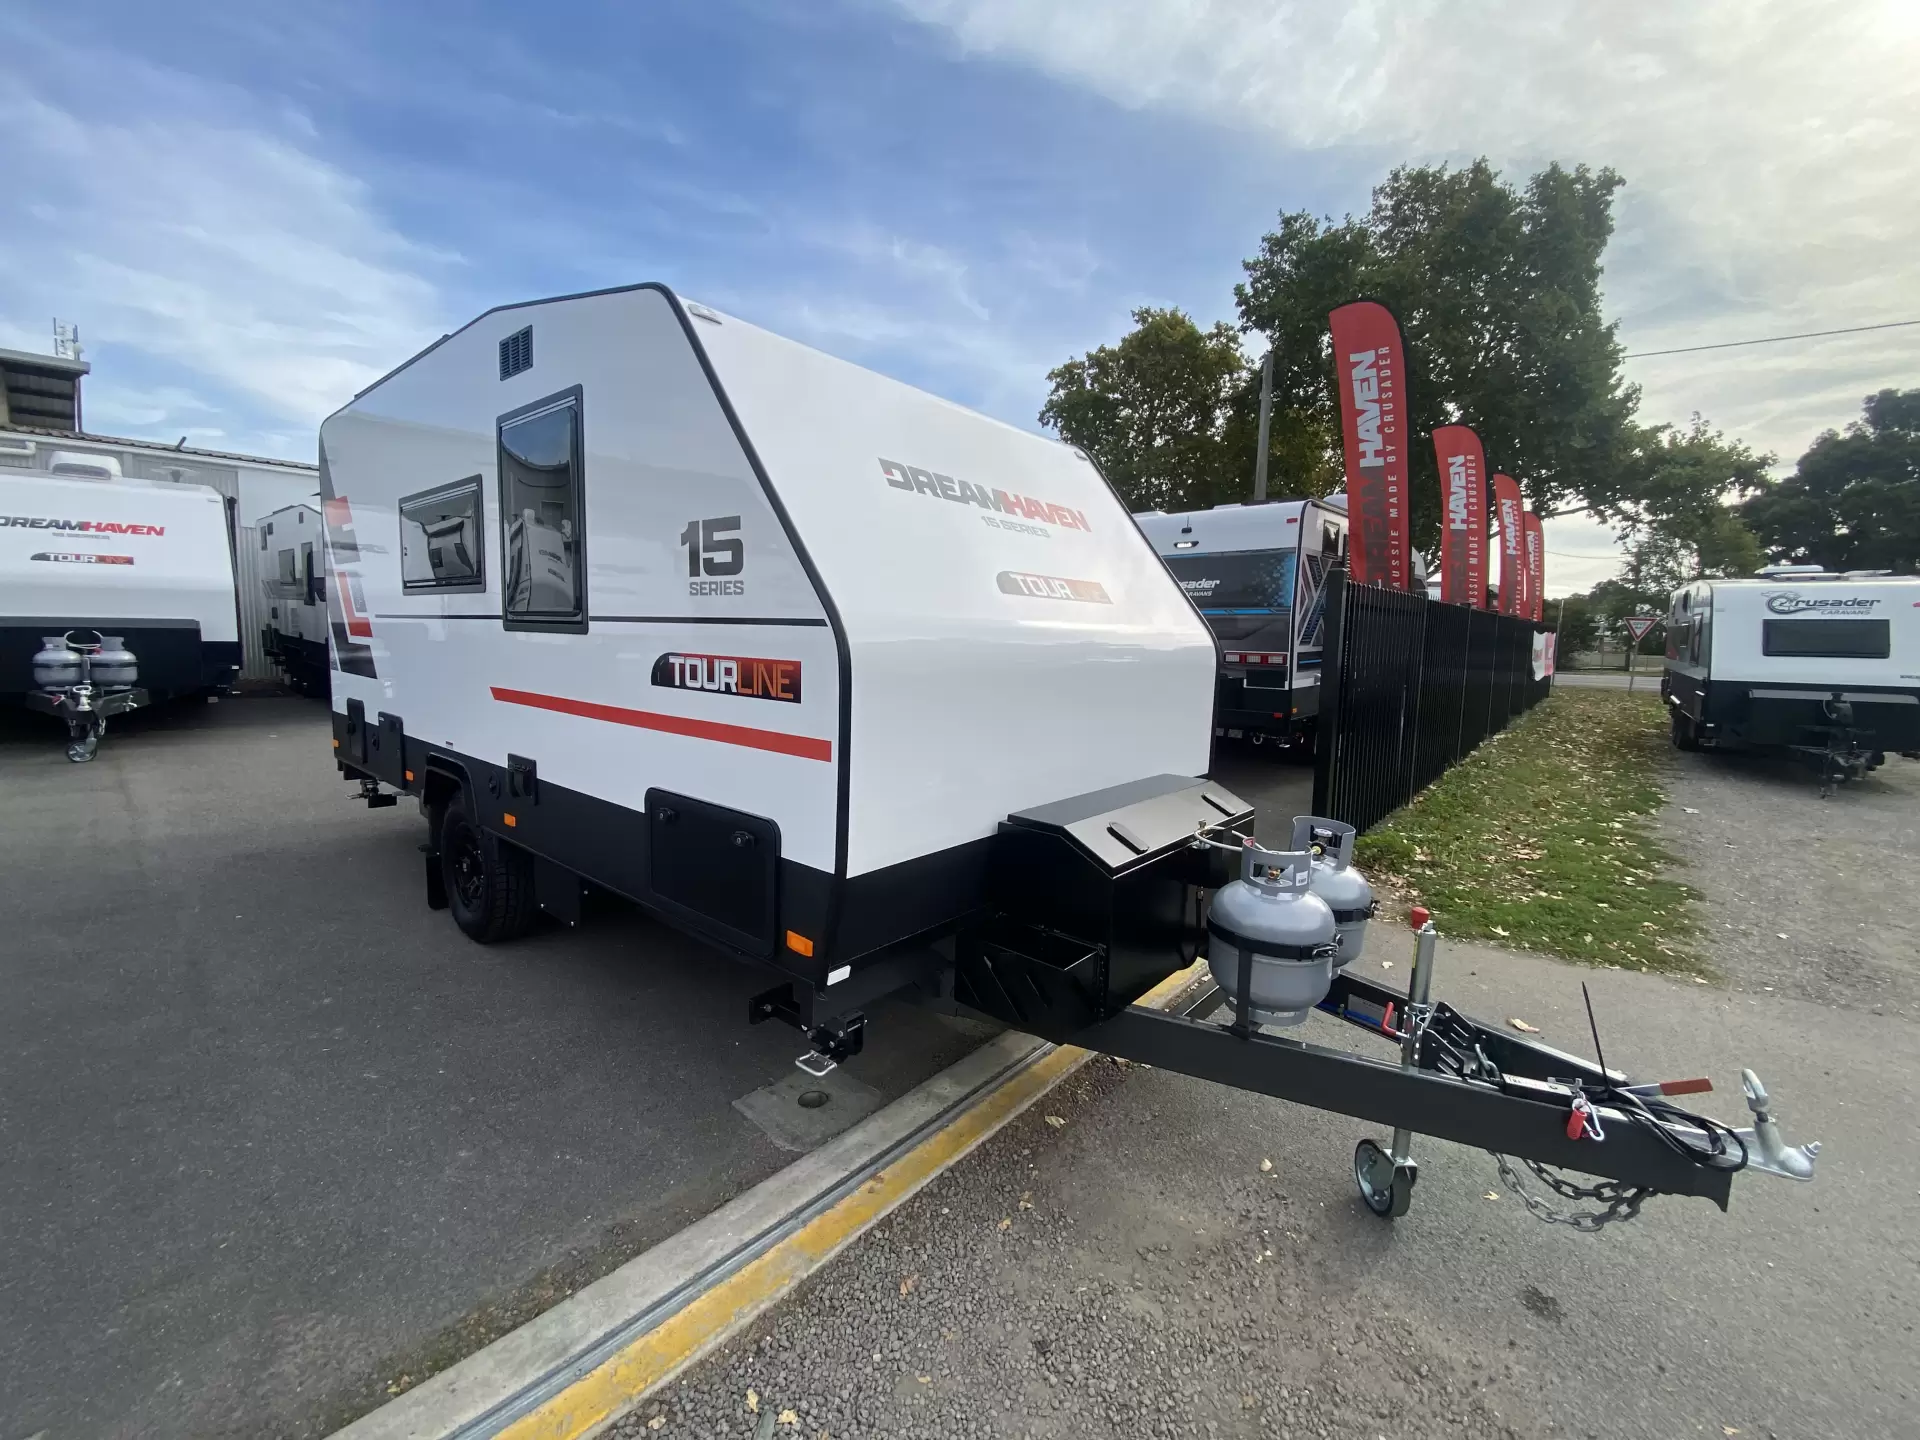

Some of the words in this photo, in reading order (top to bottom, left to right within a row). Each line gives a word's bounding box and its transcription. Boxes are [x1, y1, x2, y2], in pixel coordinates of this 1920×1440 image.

[1378, 346, 1395, 433] CRUSADER
[1386, 445, 1397, 463] BY
[878, 457, 1092, 532] DREAMHAVEN
[1388, 474, 1398, 518] MADE
[1466, 455, 1478, 510] CRUSADER
[981, 515, 1000, 529] 15
[999, 519, 1051, 538] SERIES
[1469, 517, 1478, 529] BY
[680, 515, 744, 578] 15
[1469, 536, 1478, 565] MADE
[689, 580, 744, 596] SERIES
[1179, 578, 1221, 589] sader
[1767, 595, 1882, 615] Crusader
[668, 655, 795, 699] TOURLINE
